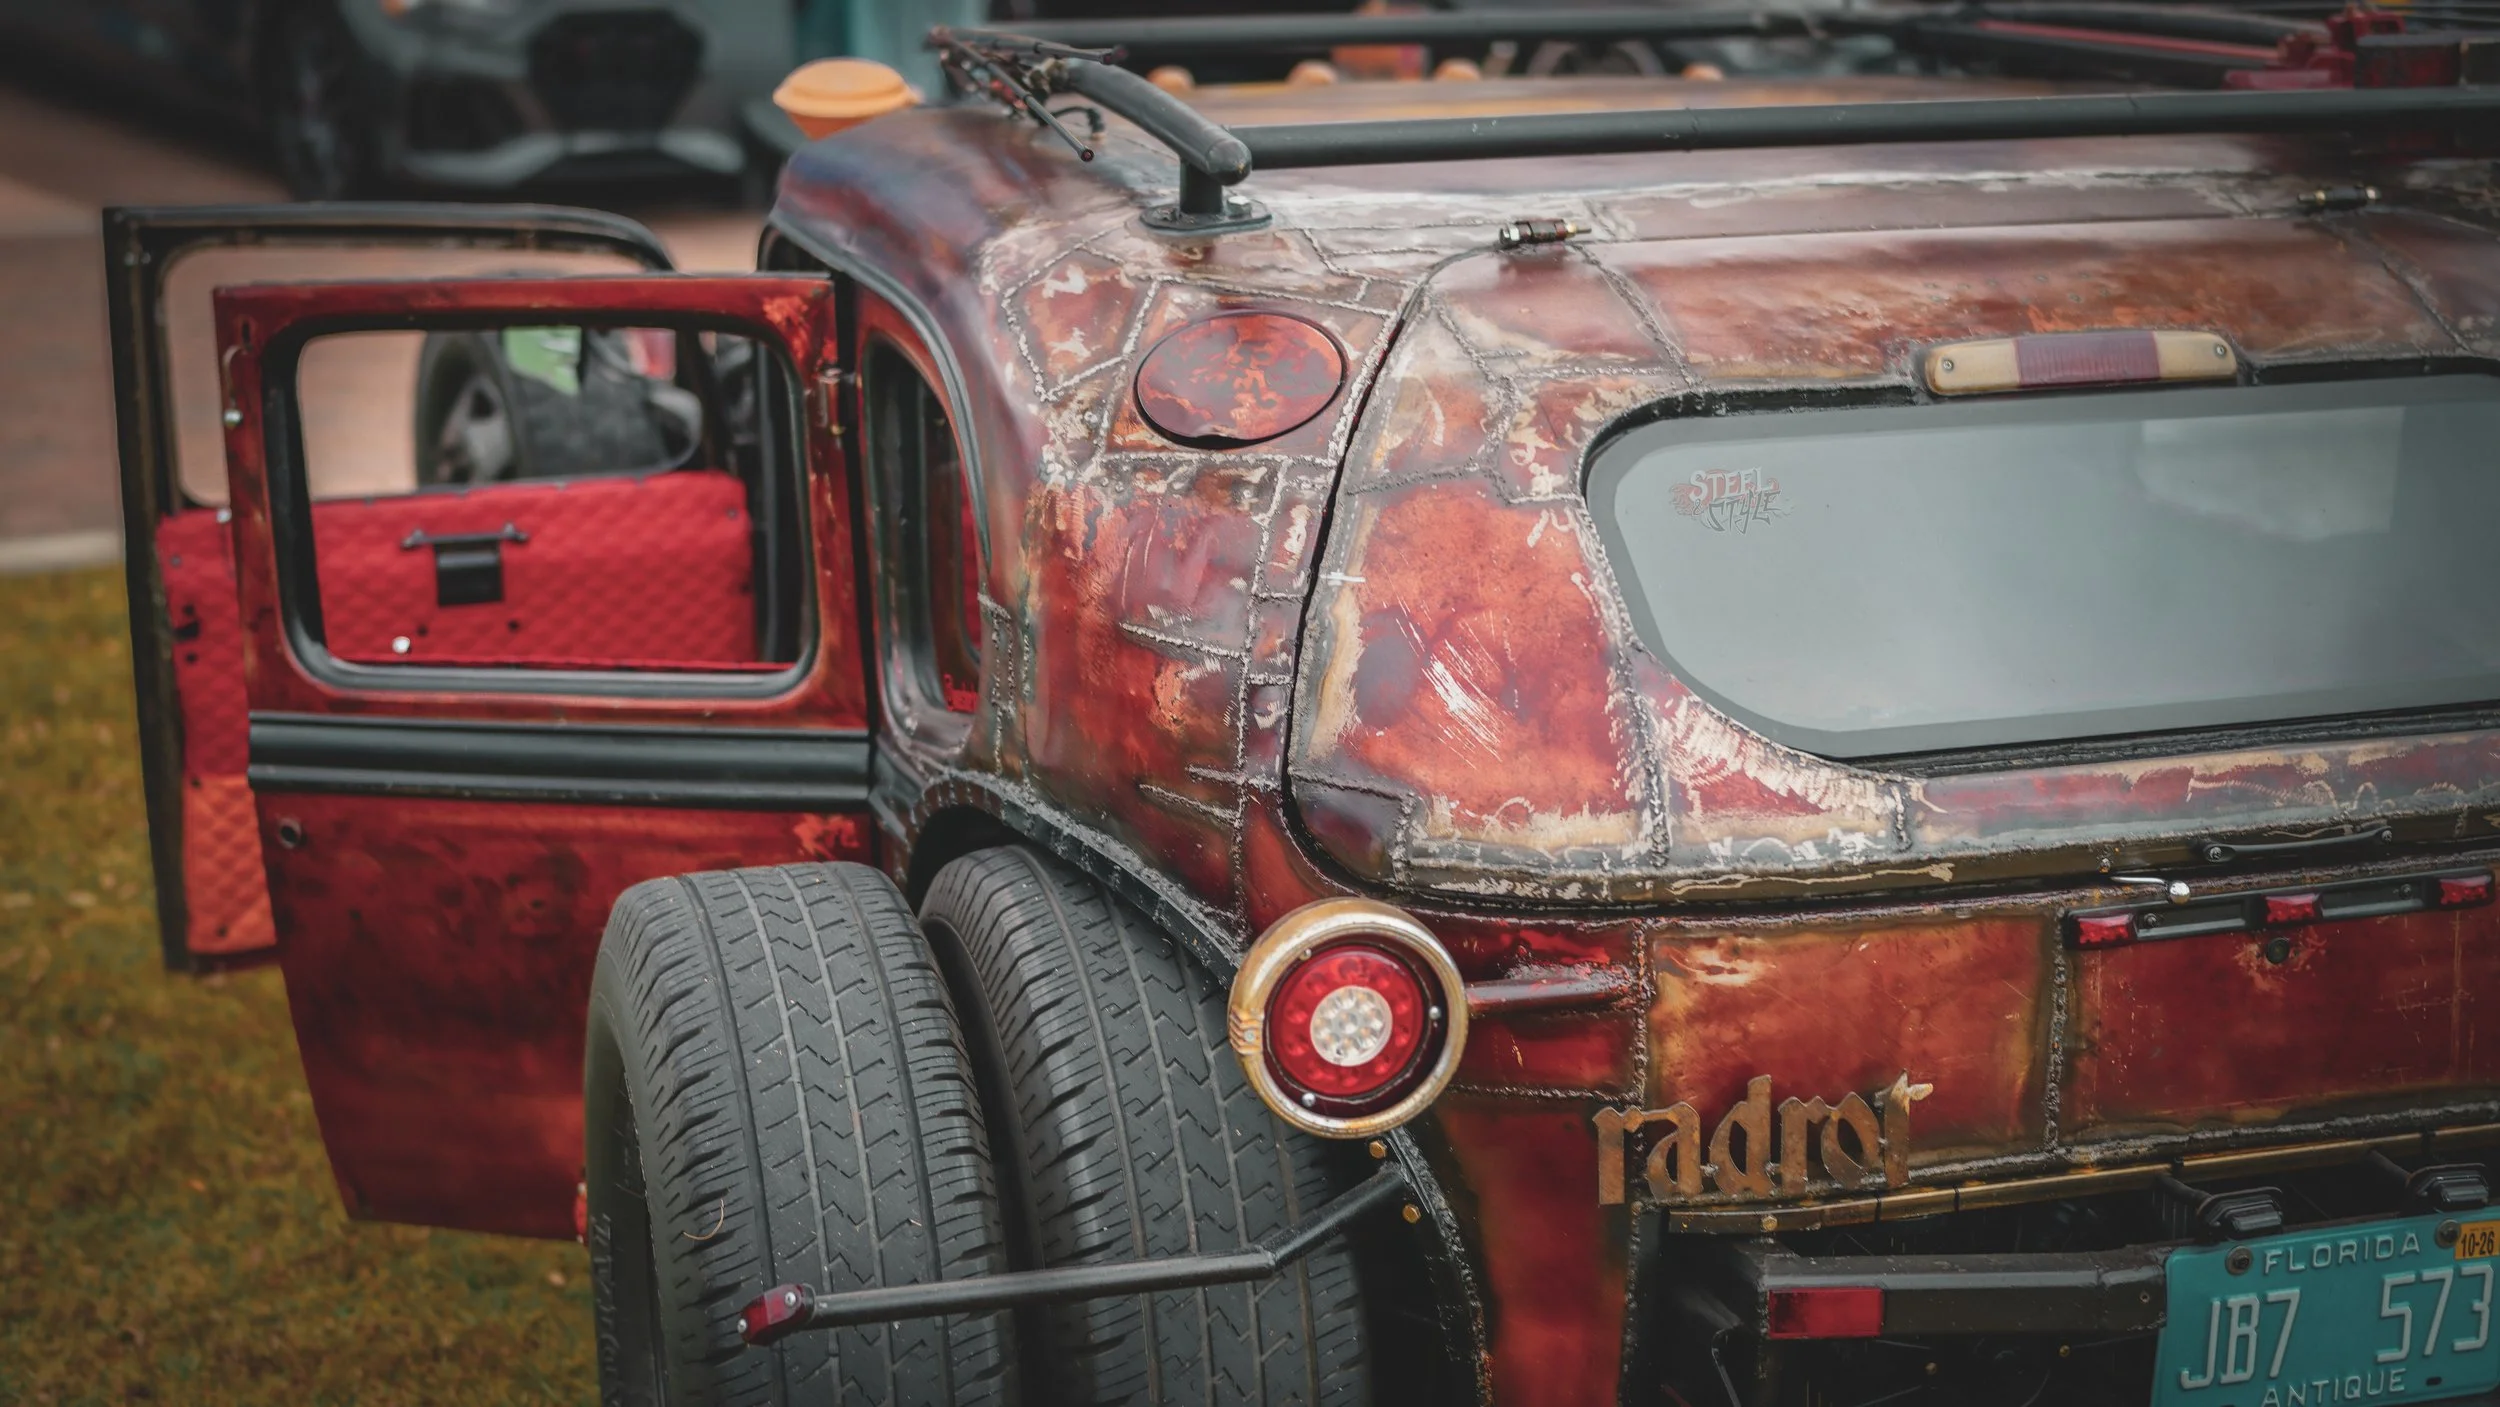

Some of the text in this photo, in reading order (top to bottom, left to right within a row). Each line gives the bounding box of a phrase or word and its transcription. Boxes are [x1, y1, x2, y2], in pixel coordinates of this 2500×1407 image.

[1688, 466, 1777, 502] STEEL
[1707, 490, 1782, 535] STYLE
[1593, 1069, 1934, 1206] radrot
[2264, 1231, 2421, 1275] FLORIDA
[2461, 1231, 2494, 1258] 10-26
[2179, 1263, 2494, 1390] JB7 573
[2259, 1367, 2408, 1407] ANTIQUE
